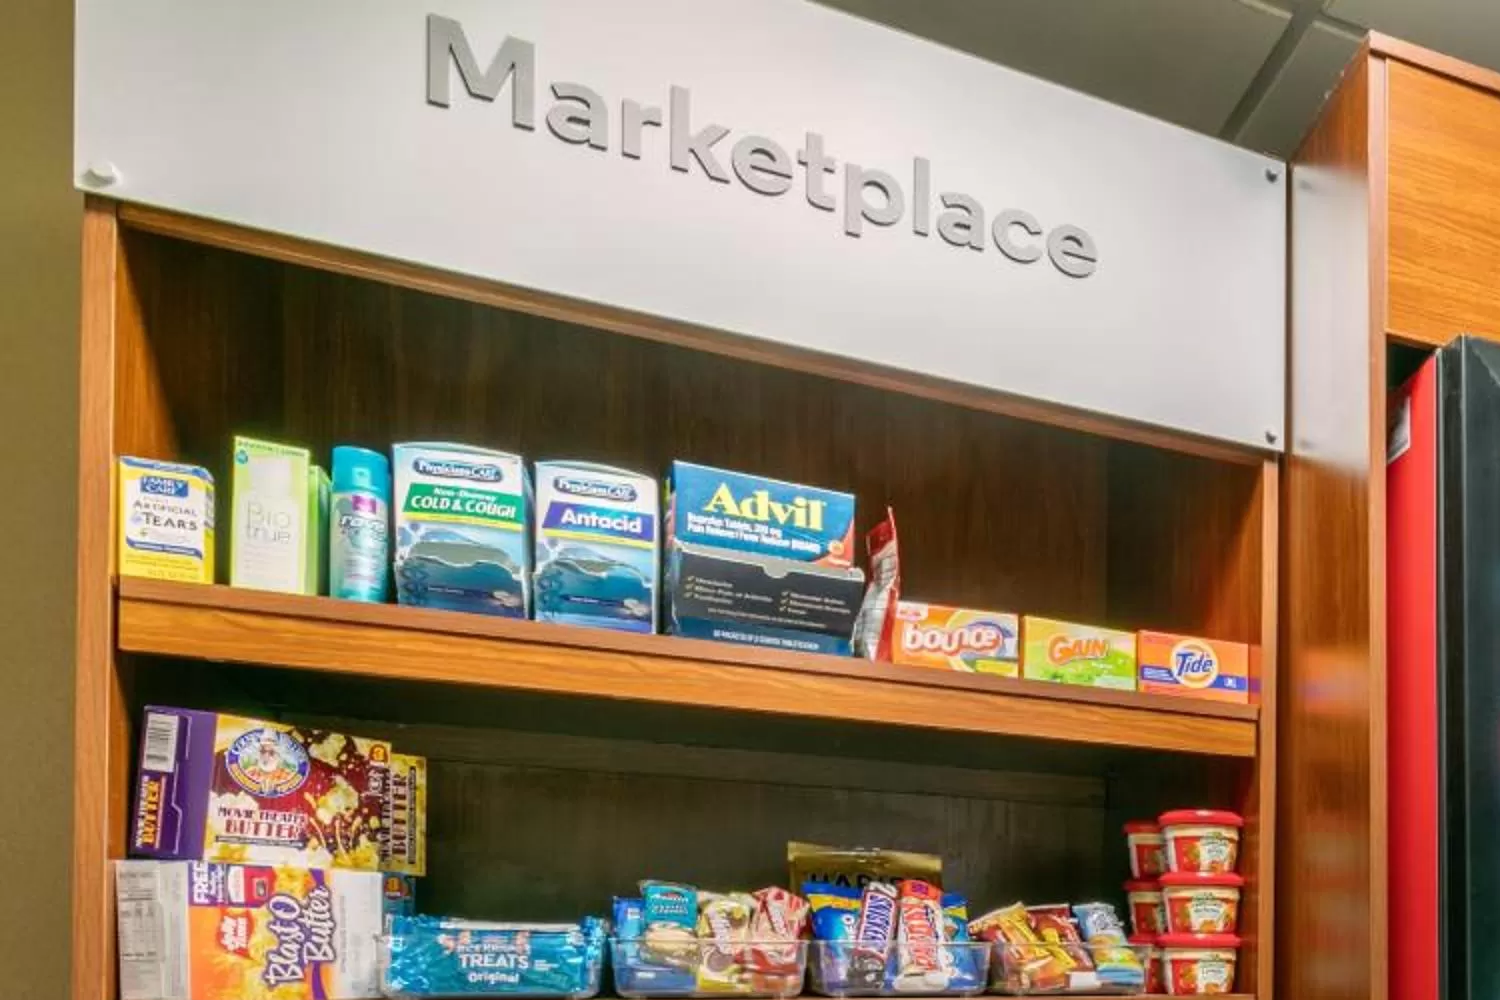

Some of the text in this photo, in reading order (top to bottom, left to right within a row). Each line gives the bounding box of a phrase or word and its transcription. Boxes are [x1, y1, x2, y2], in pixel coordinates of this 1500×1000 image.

[424, 13, 1099, 277] Marketplace
[410, 495, 450, 510] COLD
[465, 500, 517, 519] COUGH
[703, 481, 825, 531] Advil
[141, 511, 198, 531] TEARS
[561, 508, 643, 533] Antacid
[904, 623, 1001, 656] bounce
[1175, 651, 1214, 678] Tide
[225, 819, 301, 839] BUTTER
[298, 886, 335, 964] Butter
[266, 895, 305, 985] Blast O
[459, 953, 529, 969] TREATS
[468, 972, 519, 984] Original
